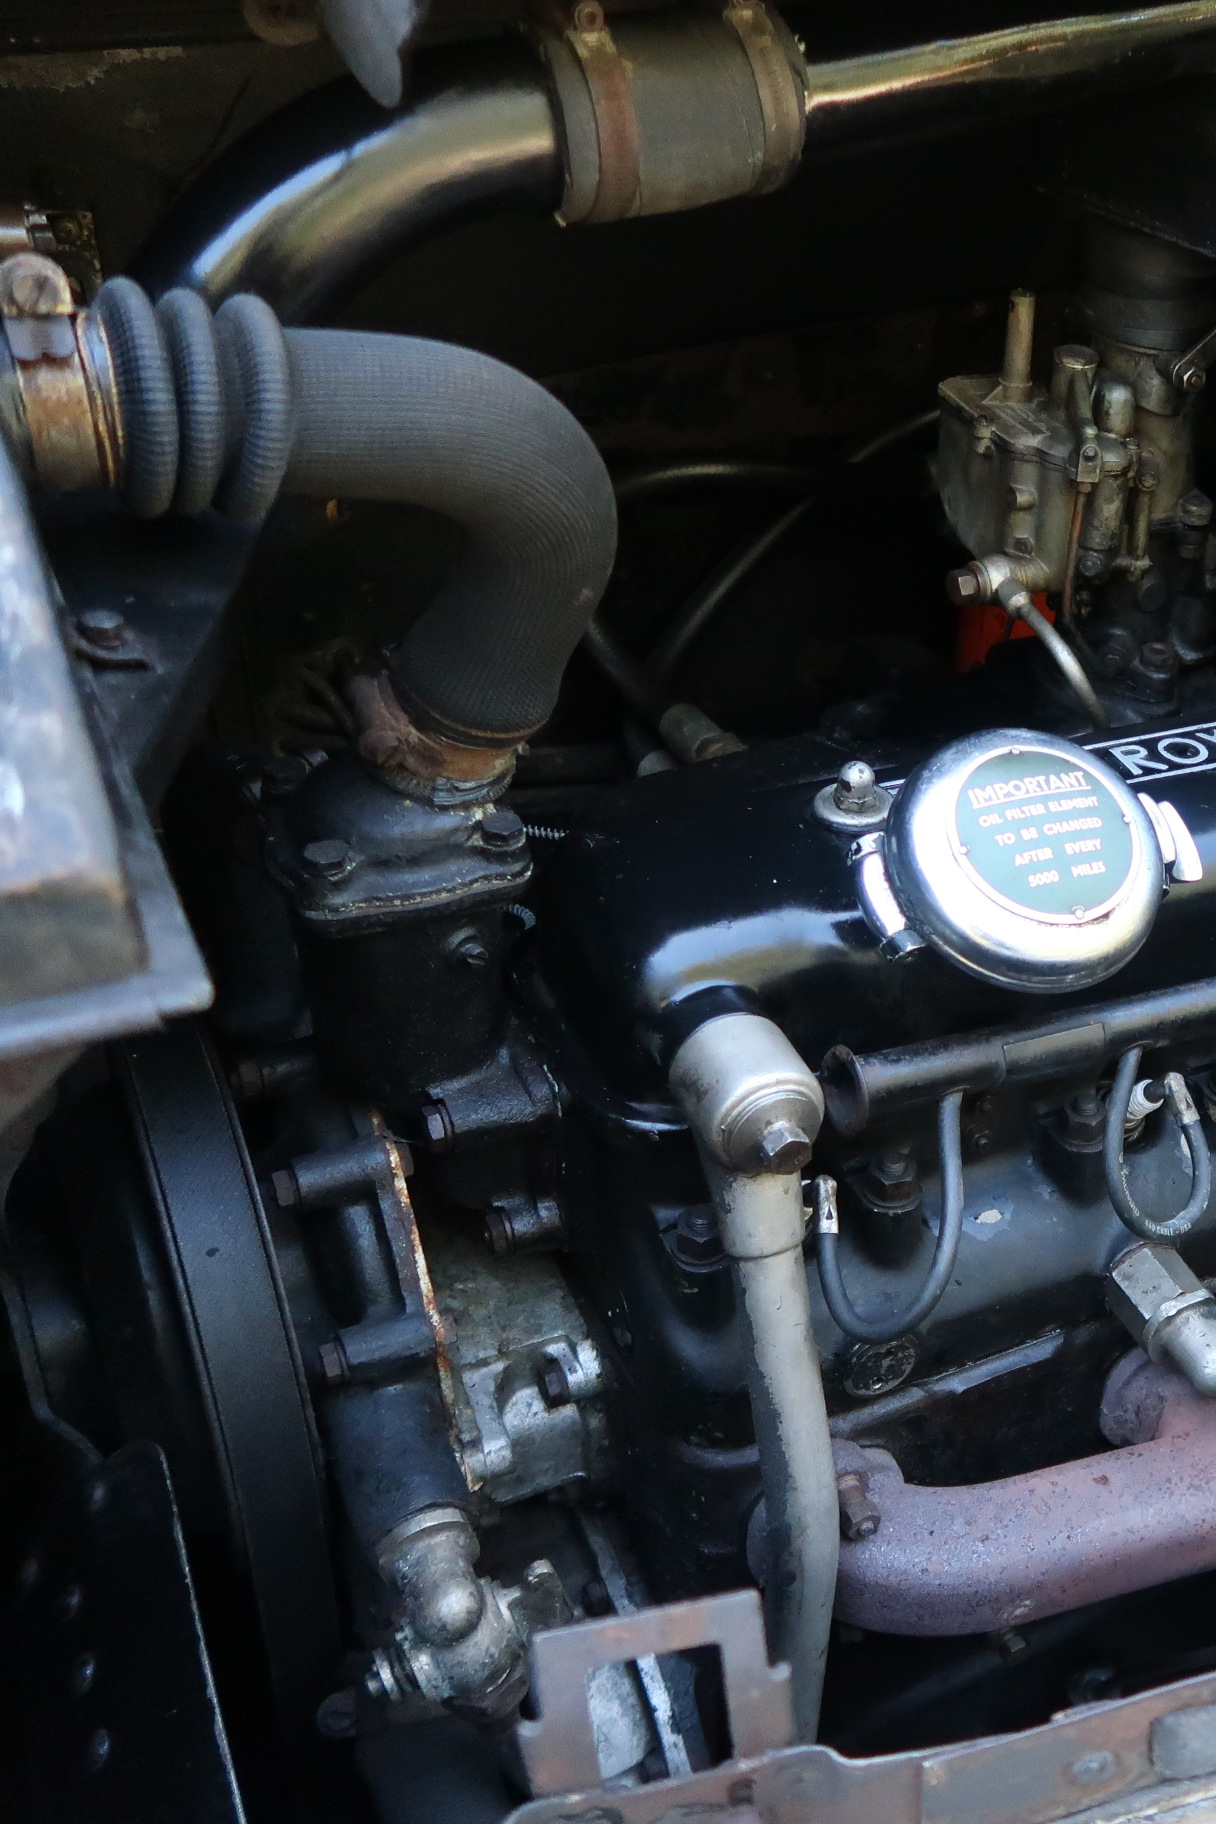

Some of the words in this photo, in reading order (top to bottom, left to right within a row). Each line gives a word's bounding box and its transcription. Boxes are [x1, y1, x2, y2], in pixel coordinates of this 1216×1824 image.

[967, 771, 1088, 807] IMPORTANT
[978, 812, 1004, 828] OIL
[1004, 803, 1047, 822] FILTER
[1048, 796, 1099, 814] ELEMENT
[994, 832, 1016, 847] TO
[1020, 828, 1039, 841] BE
[1043, 817, 1103, 836] CHANGED
[1014, 847, 1054, 867] AFTER
[1064, 838, 1102, 856] EVERY
[1027, 870, 1060, 888] 5000
[1071, 861, 1106, 878] MILES
[1156, 1225, 1174, 1236] CABLE
[1180, 1222, 1192, 1234] USA
